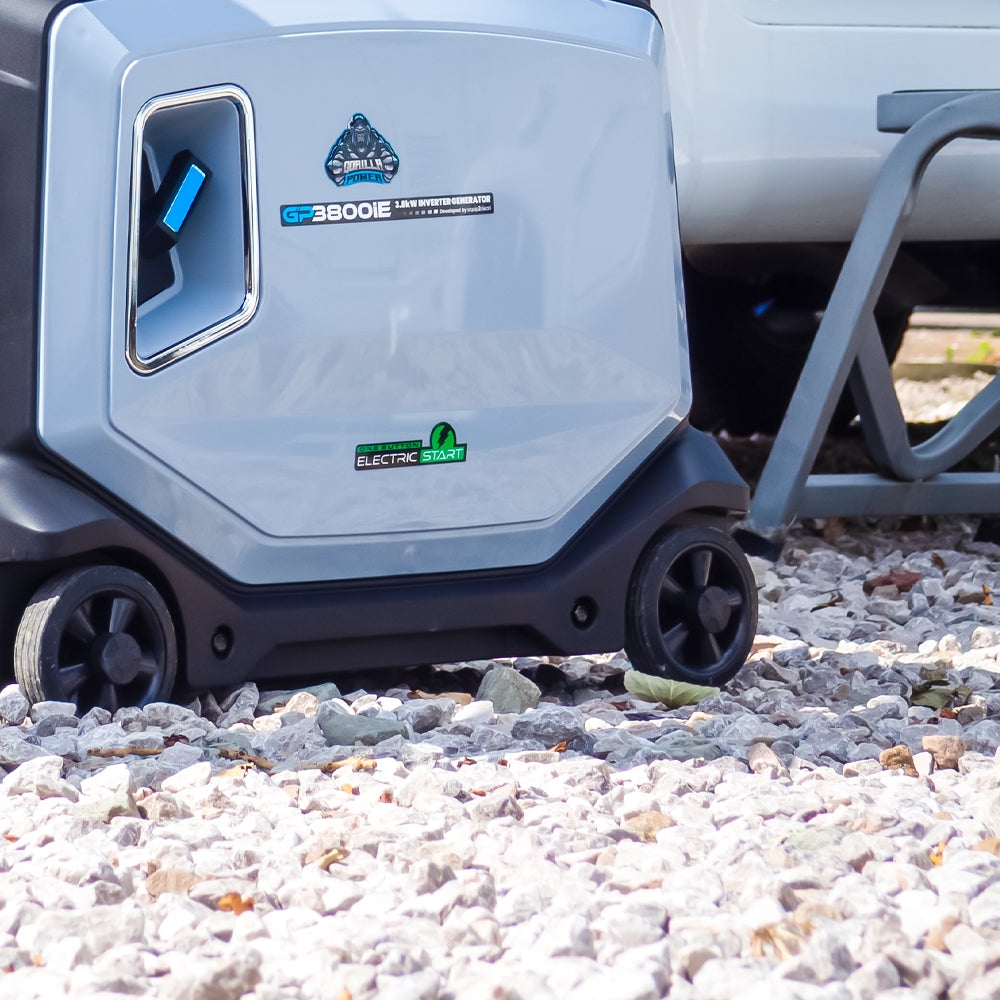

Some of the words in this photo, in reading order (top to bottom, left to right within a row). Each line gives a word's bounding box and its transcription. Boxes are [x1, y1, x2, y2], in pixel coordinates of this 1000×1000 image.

[343, 158, 383, 173] GORILLA
[345, 172, 384, 184] POWER
[418, 197, 451, 207] INVERTER
[451, 195, 491, 205] GENERATOR
[282, 201, 392, 223] GP3800iE
[381, 442, 420, 451] BUTTON
[357, 451, 418, 467] ELECTRIC
[422, 447, 464, 462] START
